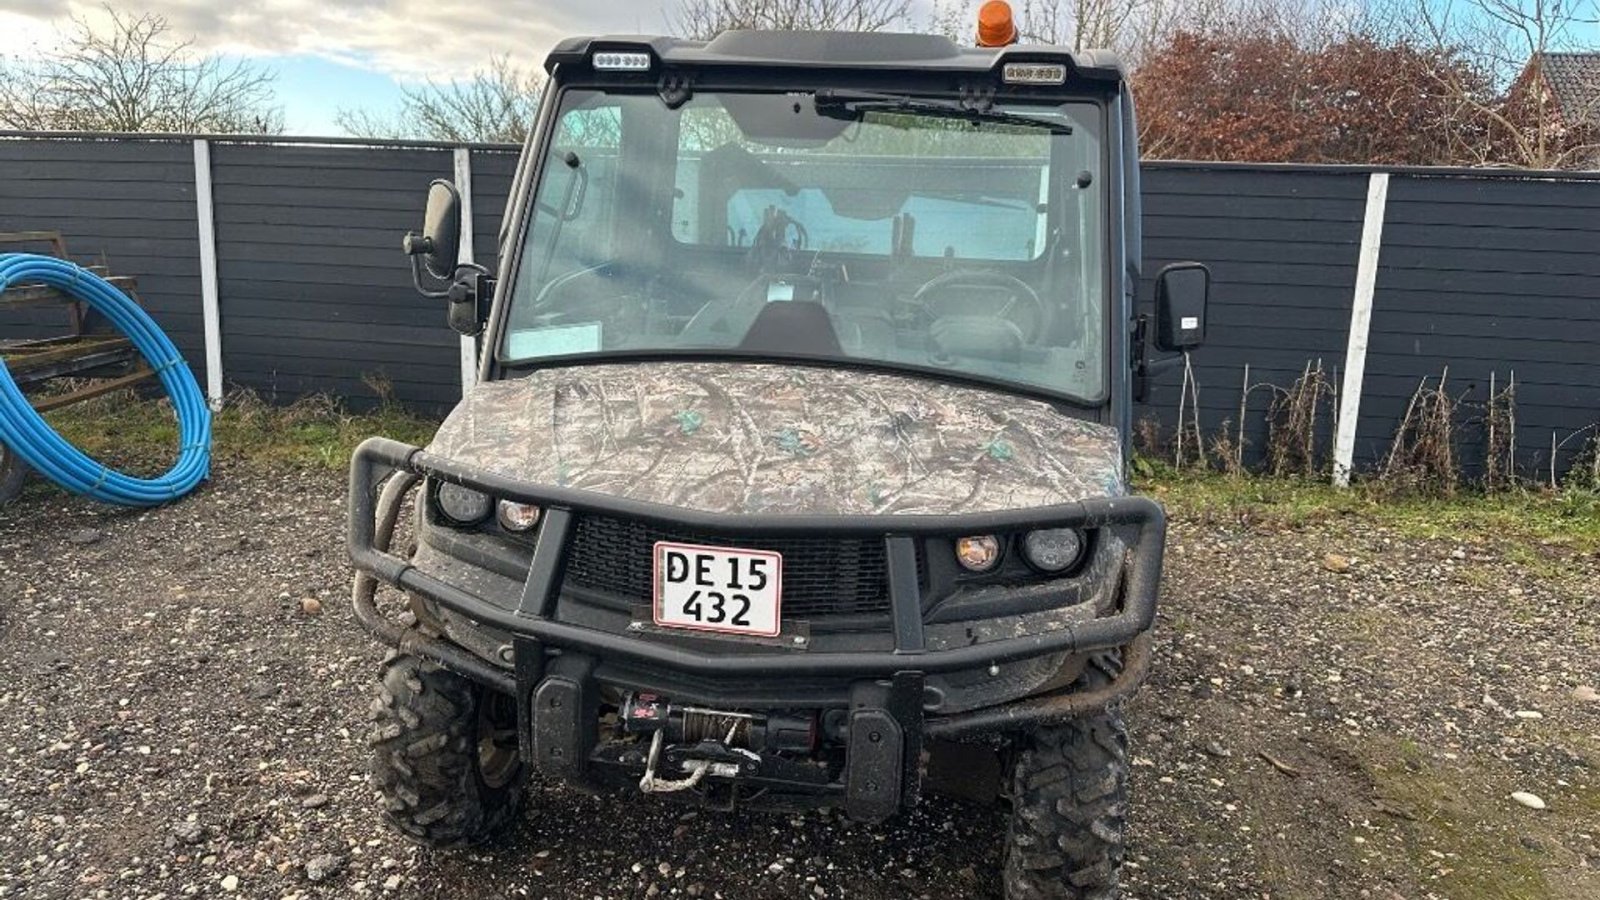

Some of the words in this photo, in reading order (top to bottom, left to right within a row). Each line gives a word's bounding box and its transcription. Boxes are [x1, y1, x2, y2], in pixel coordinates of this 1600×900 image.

[667, 552, 715, 586] DE
[727, 558, 767, 591] 15
[683, 591, 751, 626] 432
